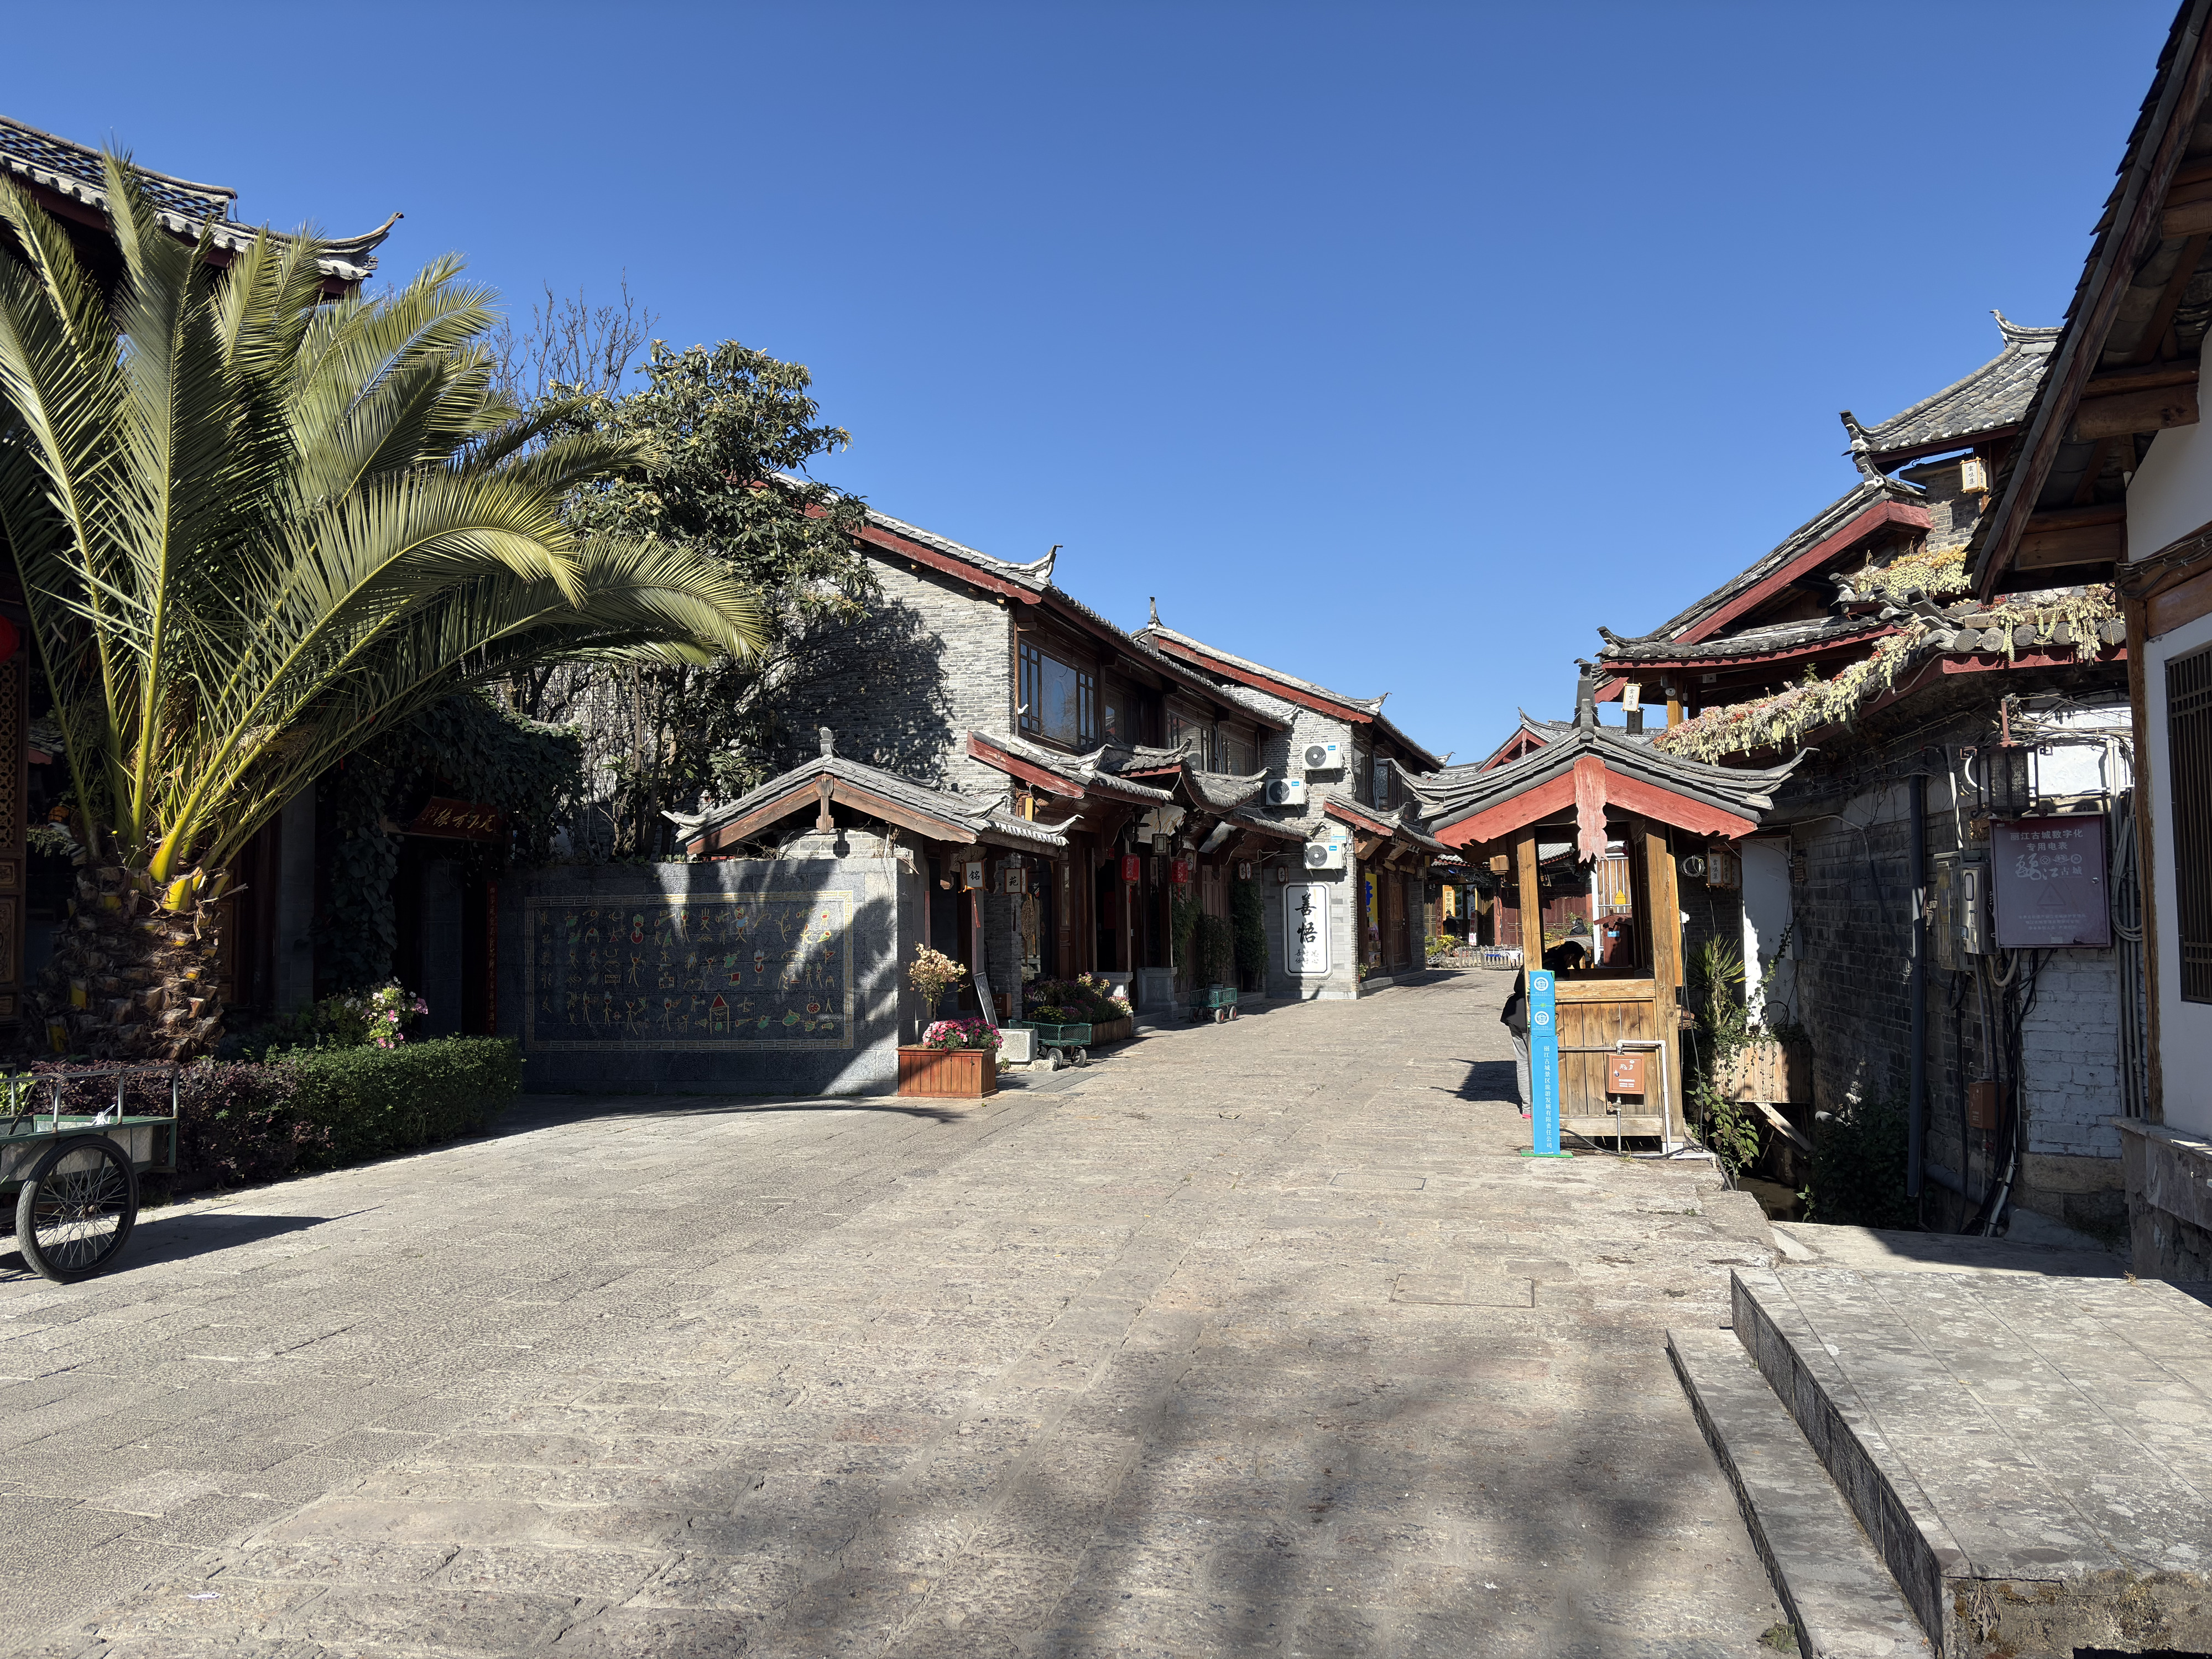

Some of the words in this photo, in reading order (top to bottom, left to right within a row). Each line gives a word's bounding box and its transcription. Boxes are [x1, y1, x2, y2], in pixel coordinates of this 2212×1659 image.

[2010, 828, 2084, 841] 丽江古城数字化
[2026, 842, 2068, 852] 专用电表
[969, 870, 980, 880] 铭
[1009, 875, 1019, 886] 苑
[1295, 892, 1318, 945] 善悟
[1543, 1045, 1552, 1149] 丽江古城景区旅游发展有限责任公司
